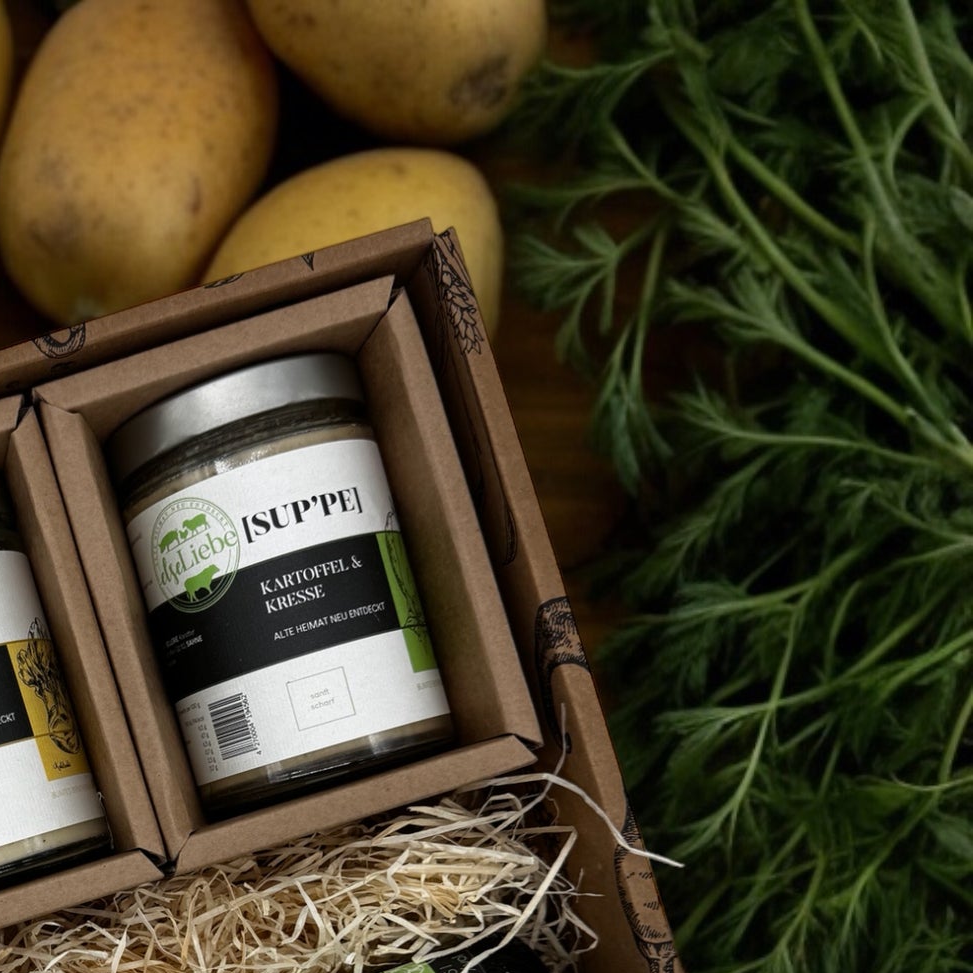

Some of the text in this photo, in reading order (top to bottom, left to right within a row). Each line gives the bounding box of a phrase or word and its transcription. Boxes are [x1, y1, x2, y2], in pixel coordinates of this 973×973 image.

[242, 487, 363, 544] [SUP'PE]
[159, 530, 238, 585] elseLiebe
[260, 555, 363, 595] KARTOFFEL &
[265, 584, 325, 614] KRESSE
[274, 602, 385, 641] ALTE HEIMAT NEU ENTDECKT
